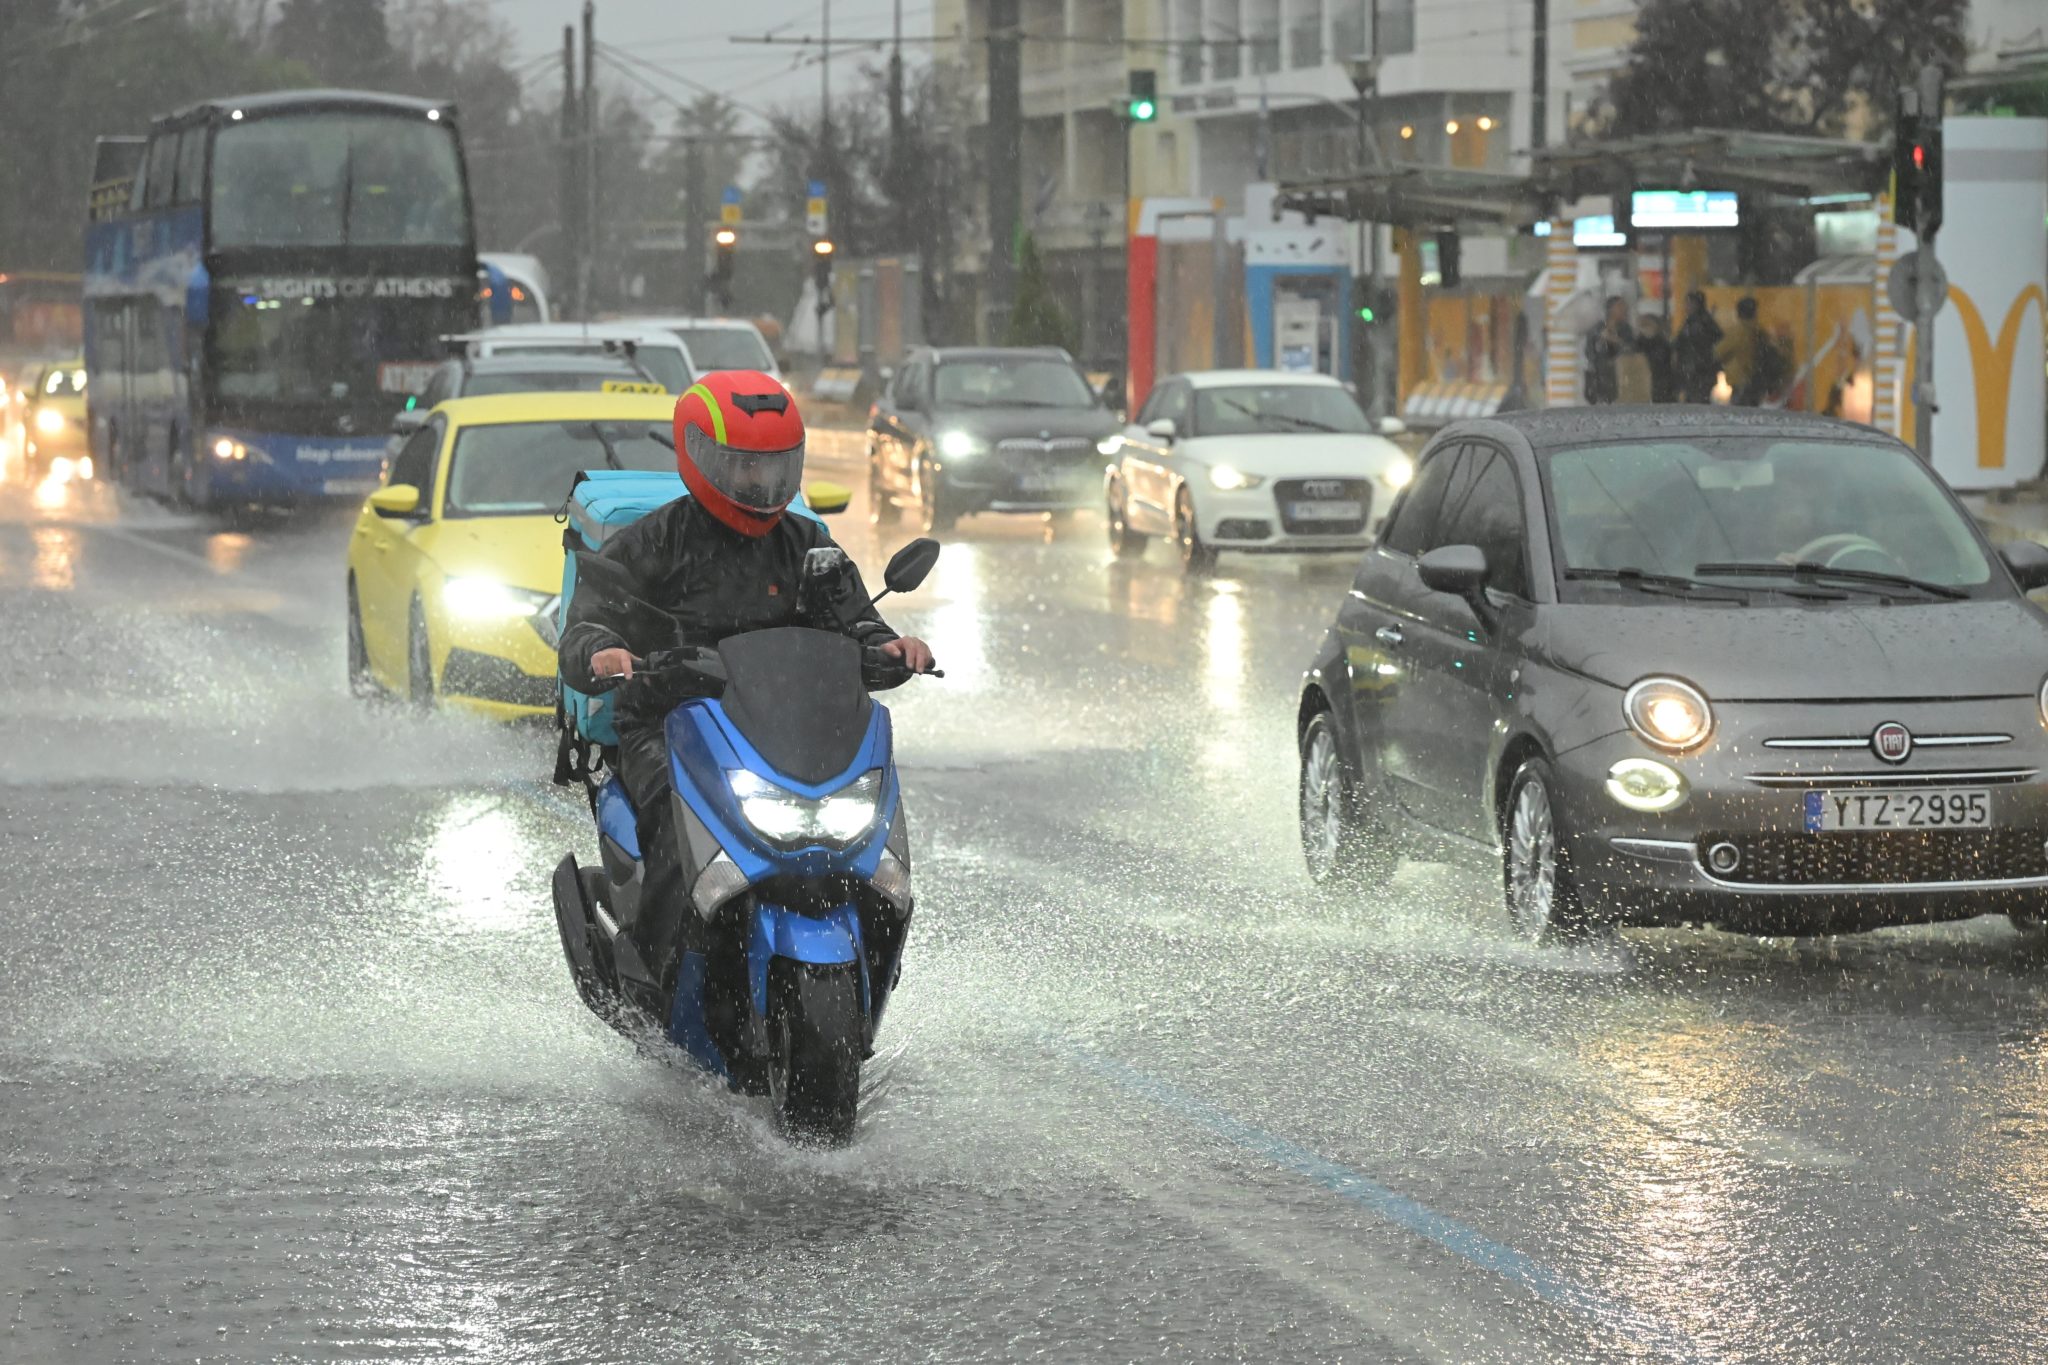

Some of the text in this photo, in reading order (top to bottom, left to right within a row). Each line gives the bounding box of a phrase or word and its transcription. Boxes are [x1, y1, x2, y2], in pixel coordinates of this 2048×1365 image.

[262, 277, 337, 298] SIGHTS
[372, 276, 453, 297] ATHENS
[381, 365, 434, 394] ATHE
[608, 383, 661, 394] TAXI
[1882, 733, 1904, 750] FIAT
[1833, 793, 1987, 827] YTZ-2995
